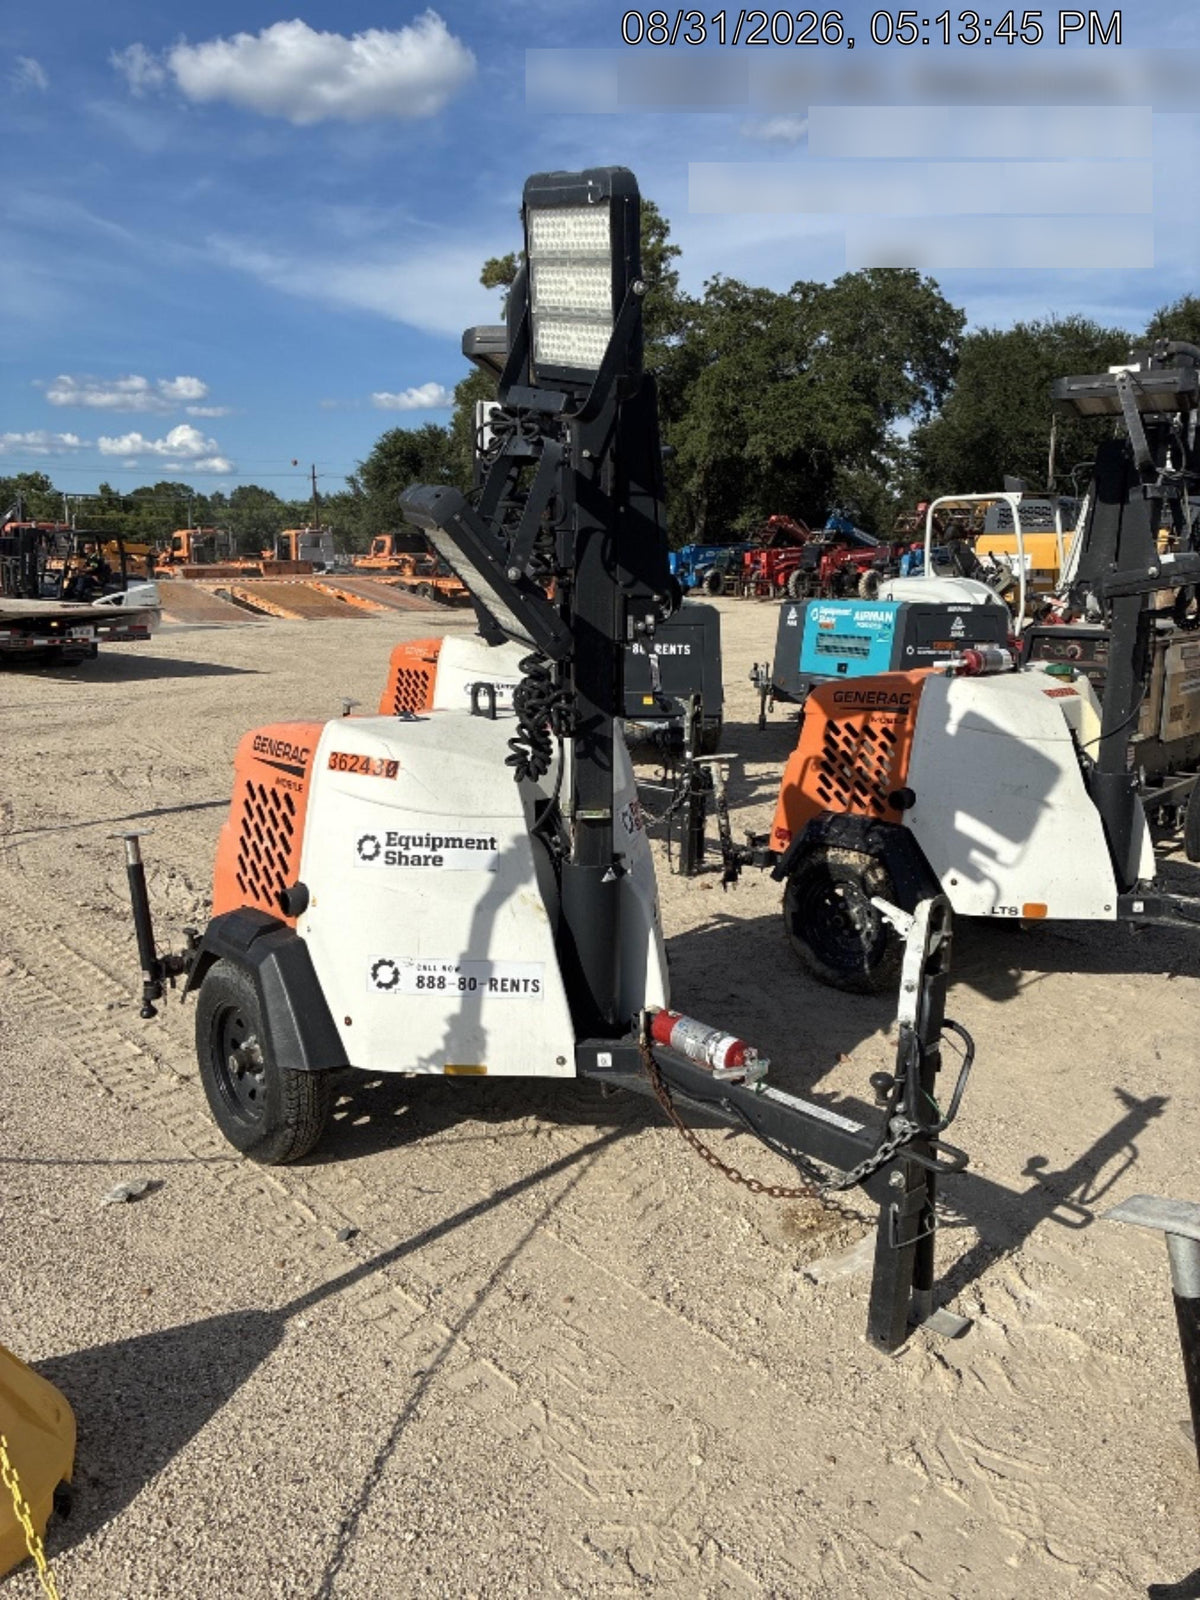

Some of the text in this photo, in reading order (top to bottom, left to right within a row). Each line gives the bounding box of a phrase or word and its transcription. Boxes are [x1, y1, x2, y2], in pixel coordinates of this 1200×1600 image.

[833, 691, 912, 705] GENERAC
[253, 735, 310, 765] GENERAC
[385, 831, 498, 851] Equipment
[385, 851, 443, 866] Share
[416, 975, 541, 993] 888-80-RENTS
